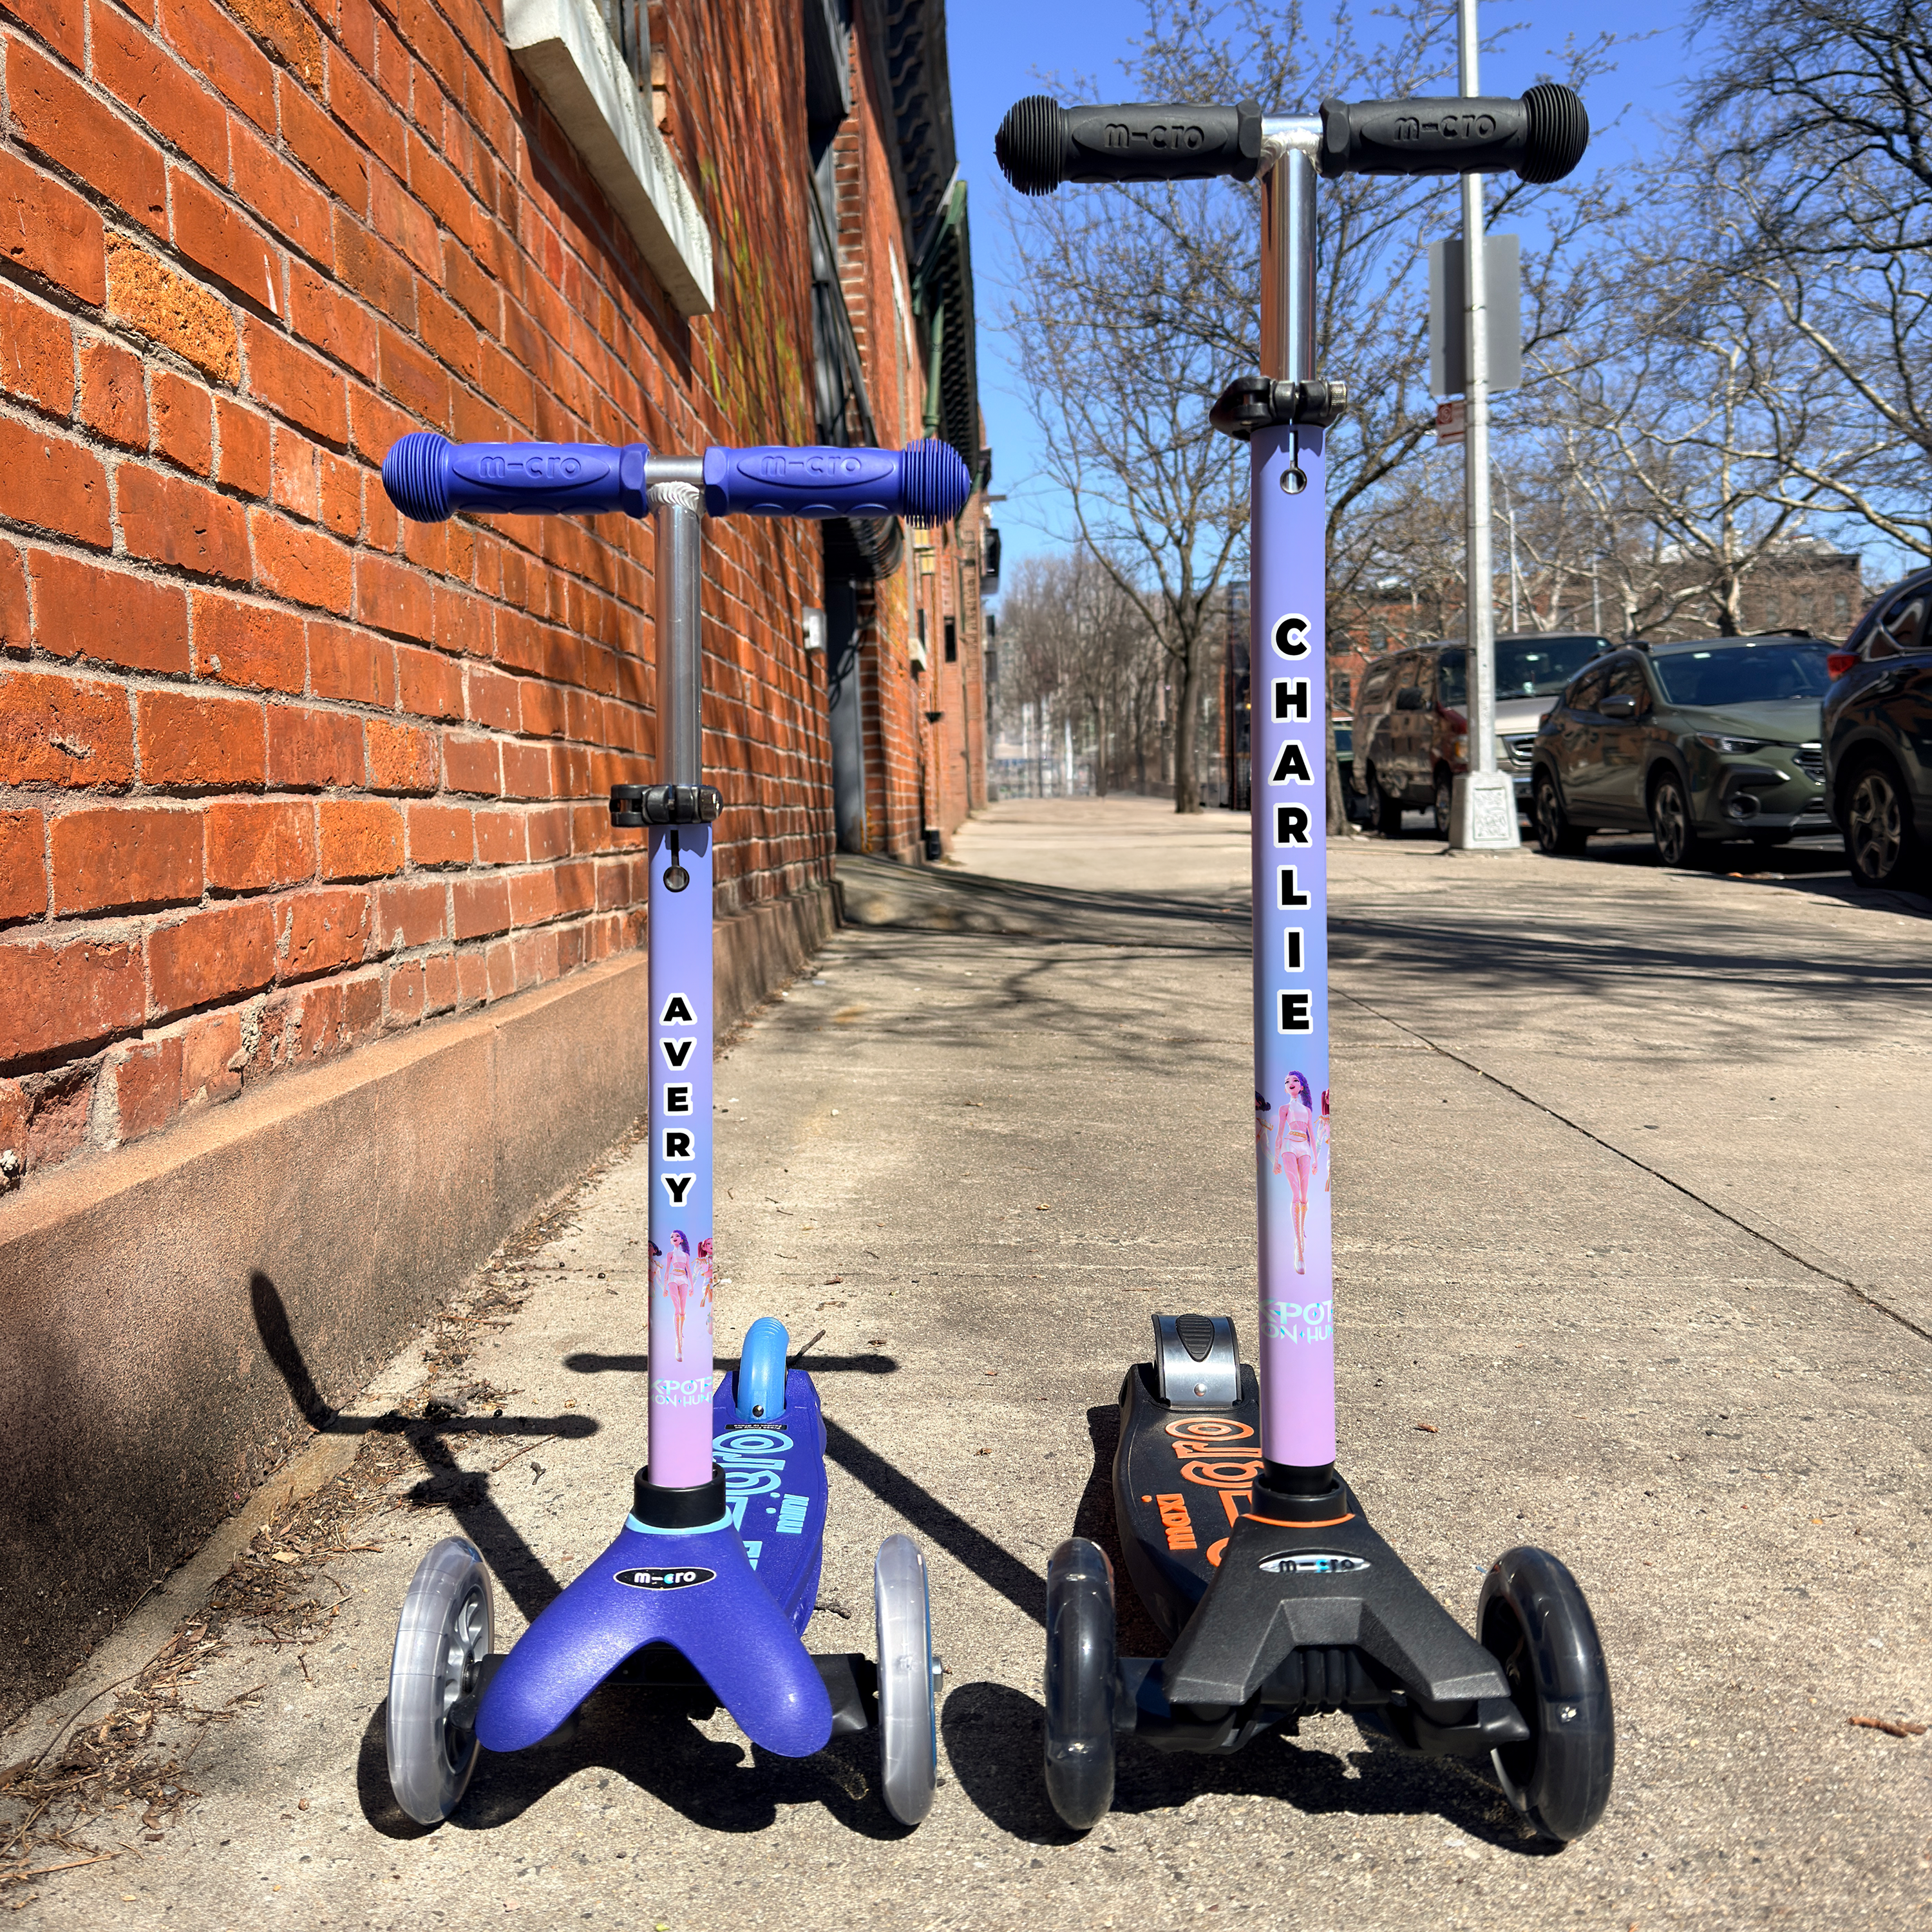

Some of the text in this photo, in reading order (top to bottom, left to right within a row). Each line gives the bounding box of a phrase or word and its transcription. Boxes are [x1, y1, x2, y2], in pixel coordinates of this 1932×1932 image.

[1268, 612, 1314, 1034] CHARLIE
[659, 992, 697, 1207] AVERY
[766, 1492, 810, 1534] mini
[1141, 1493, 1197, 1550] maxi
